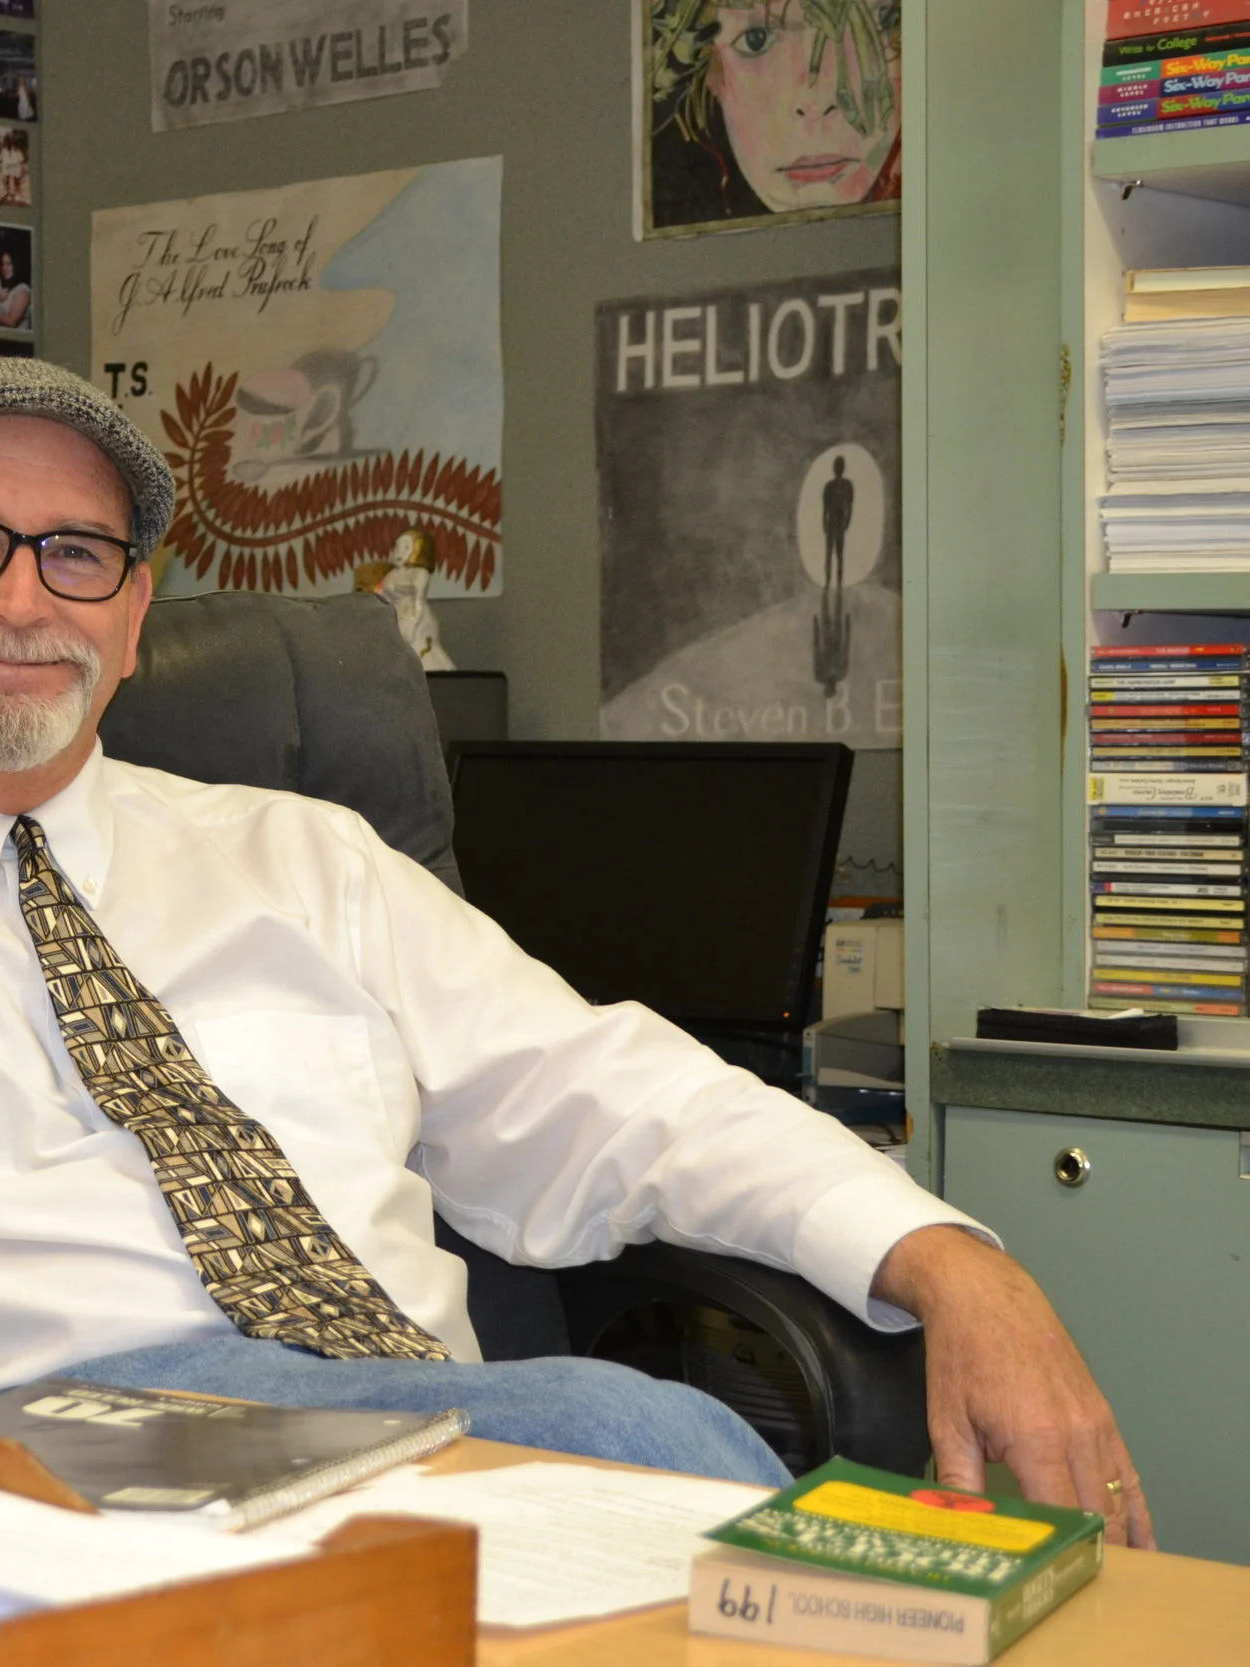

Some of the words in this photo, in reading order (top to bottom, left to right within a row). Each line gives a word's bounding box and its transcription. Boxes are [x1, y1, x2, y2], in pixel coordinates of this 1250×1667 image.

[1157, 36, 1197, 50] College
[163, 44, 284, 108] ORSON
[290, 14, 452, 88] WELLES
[1165, 57, 1225, 76] Six-Way
[1164, 75, 1224, 93] Six-Way
[1161, 96, 1222, 113] Six-Way
[133, 229, 178, 270] The
[186, 223, 240, 263] Love
[240, 217, 288, 262] Song
[294, 214, 320, 266] of
[146, 265, 231, 317] Alfred
[616, 286, 902, 393] HELIOTR
[660, 682, 808, 736] Steven
[717, 1577, 777, 1626] 199
[788, 1592, 851, 1620] SCHOOL
[853, 1602, 892, 1626] HIGH
[895, 1607, 964, 1635] PIONEER
